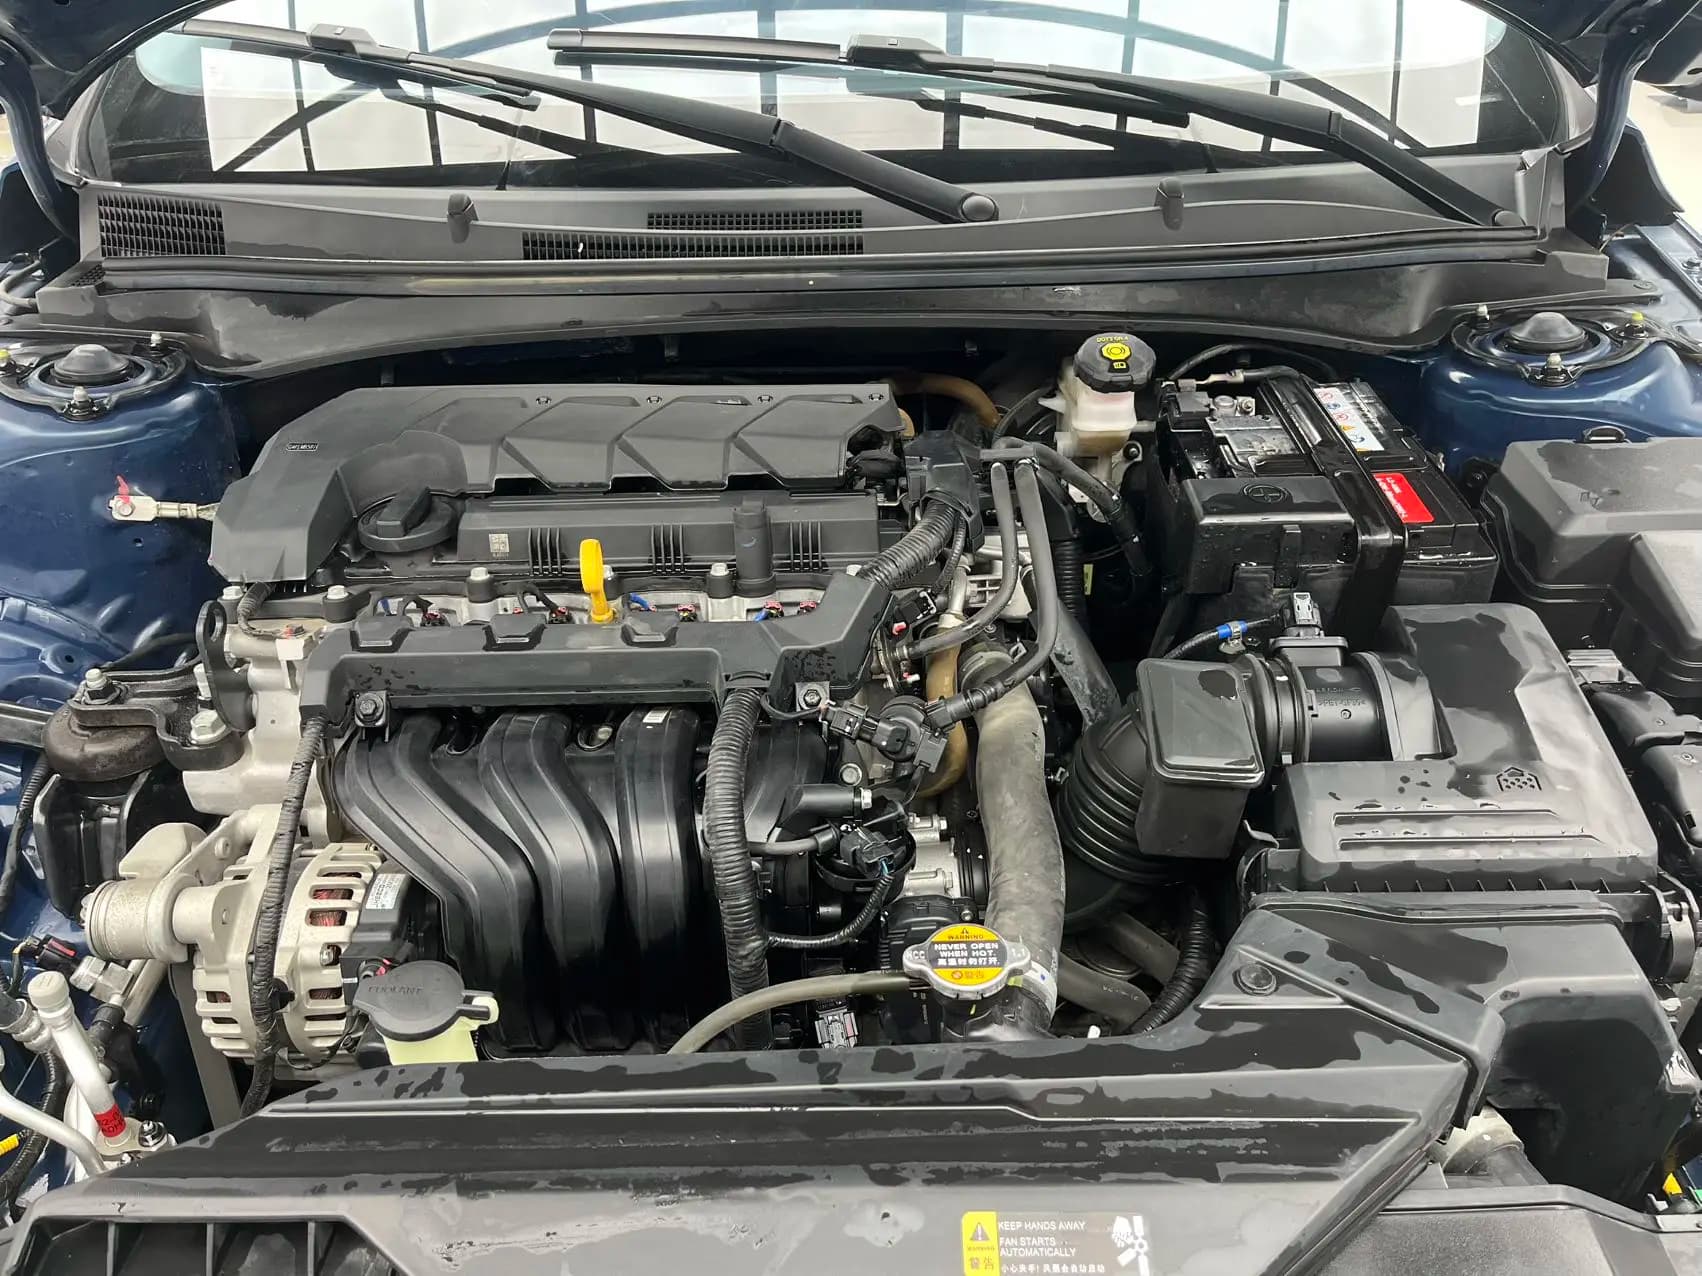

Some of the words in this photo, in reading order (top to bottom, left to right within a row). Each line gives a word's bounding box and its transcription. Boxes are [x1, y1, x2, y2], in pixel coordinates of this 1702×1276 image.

[971, 942, 999, 950] OPEN
[998, 1221, 1022, 1231] KEEP
[1024, 1221, 1057, 1231] HANDS
[1059, 1221, 1086, 1231] AWAY
[1000, 1237, 1018, 1247] FAN
[1020, 1237, 1056, 1247] STARTS
[1000, 1248, 1077, 1257] AUTOMATICALLY
